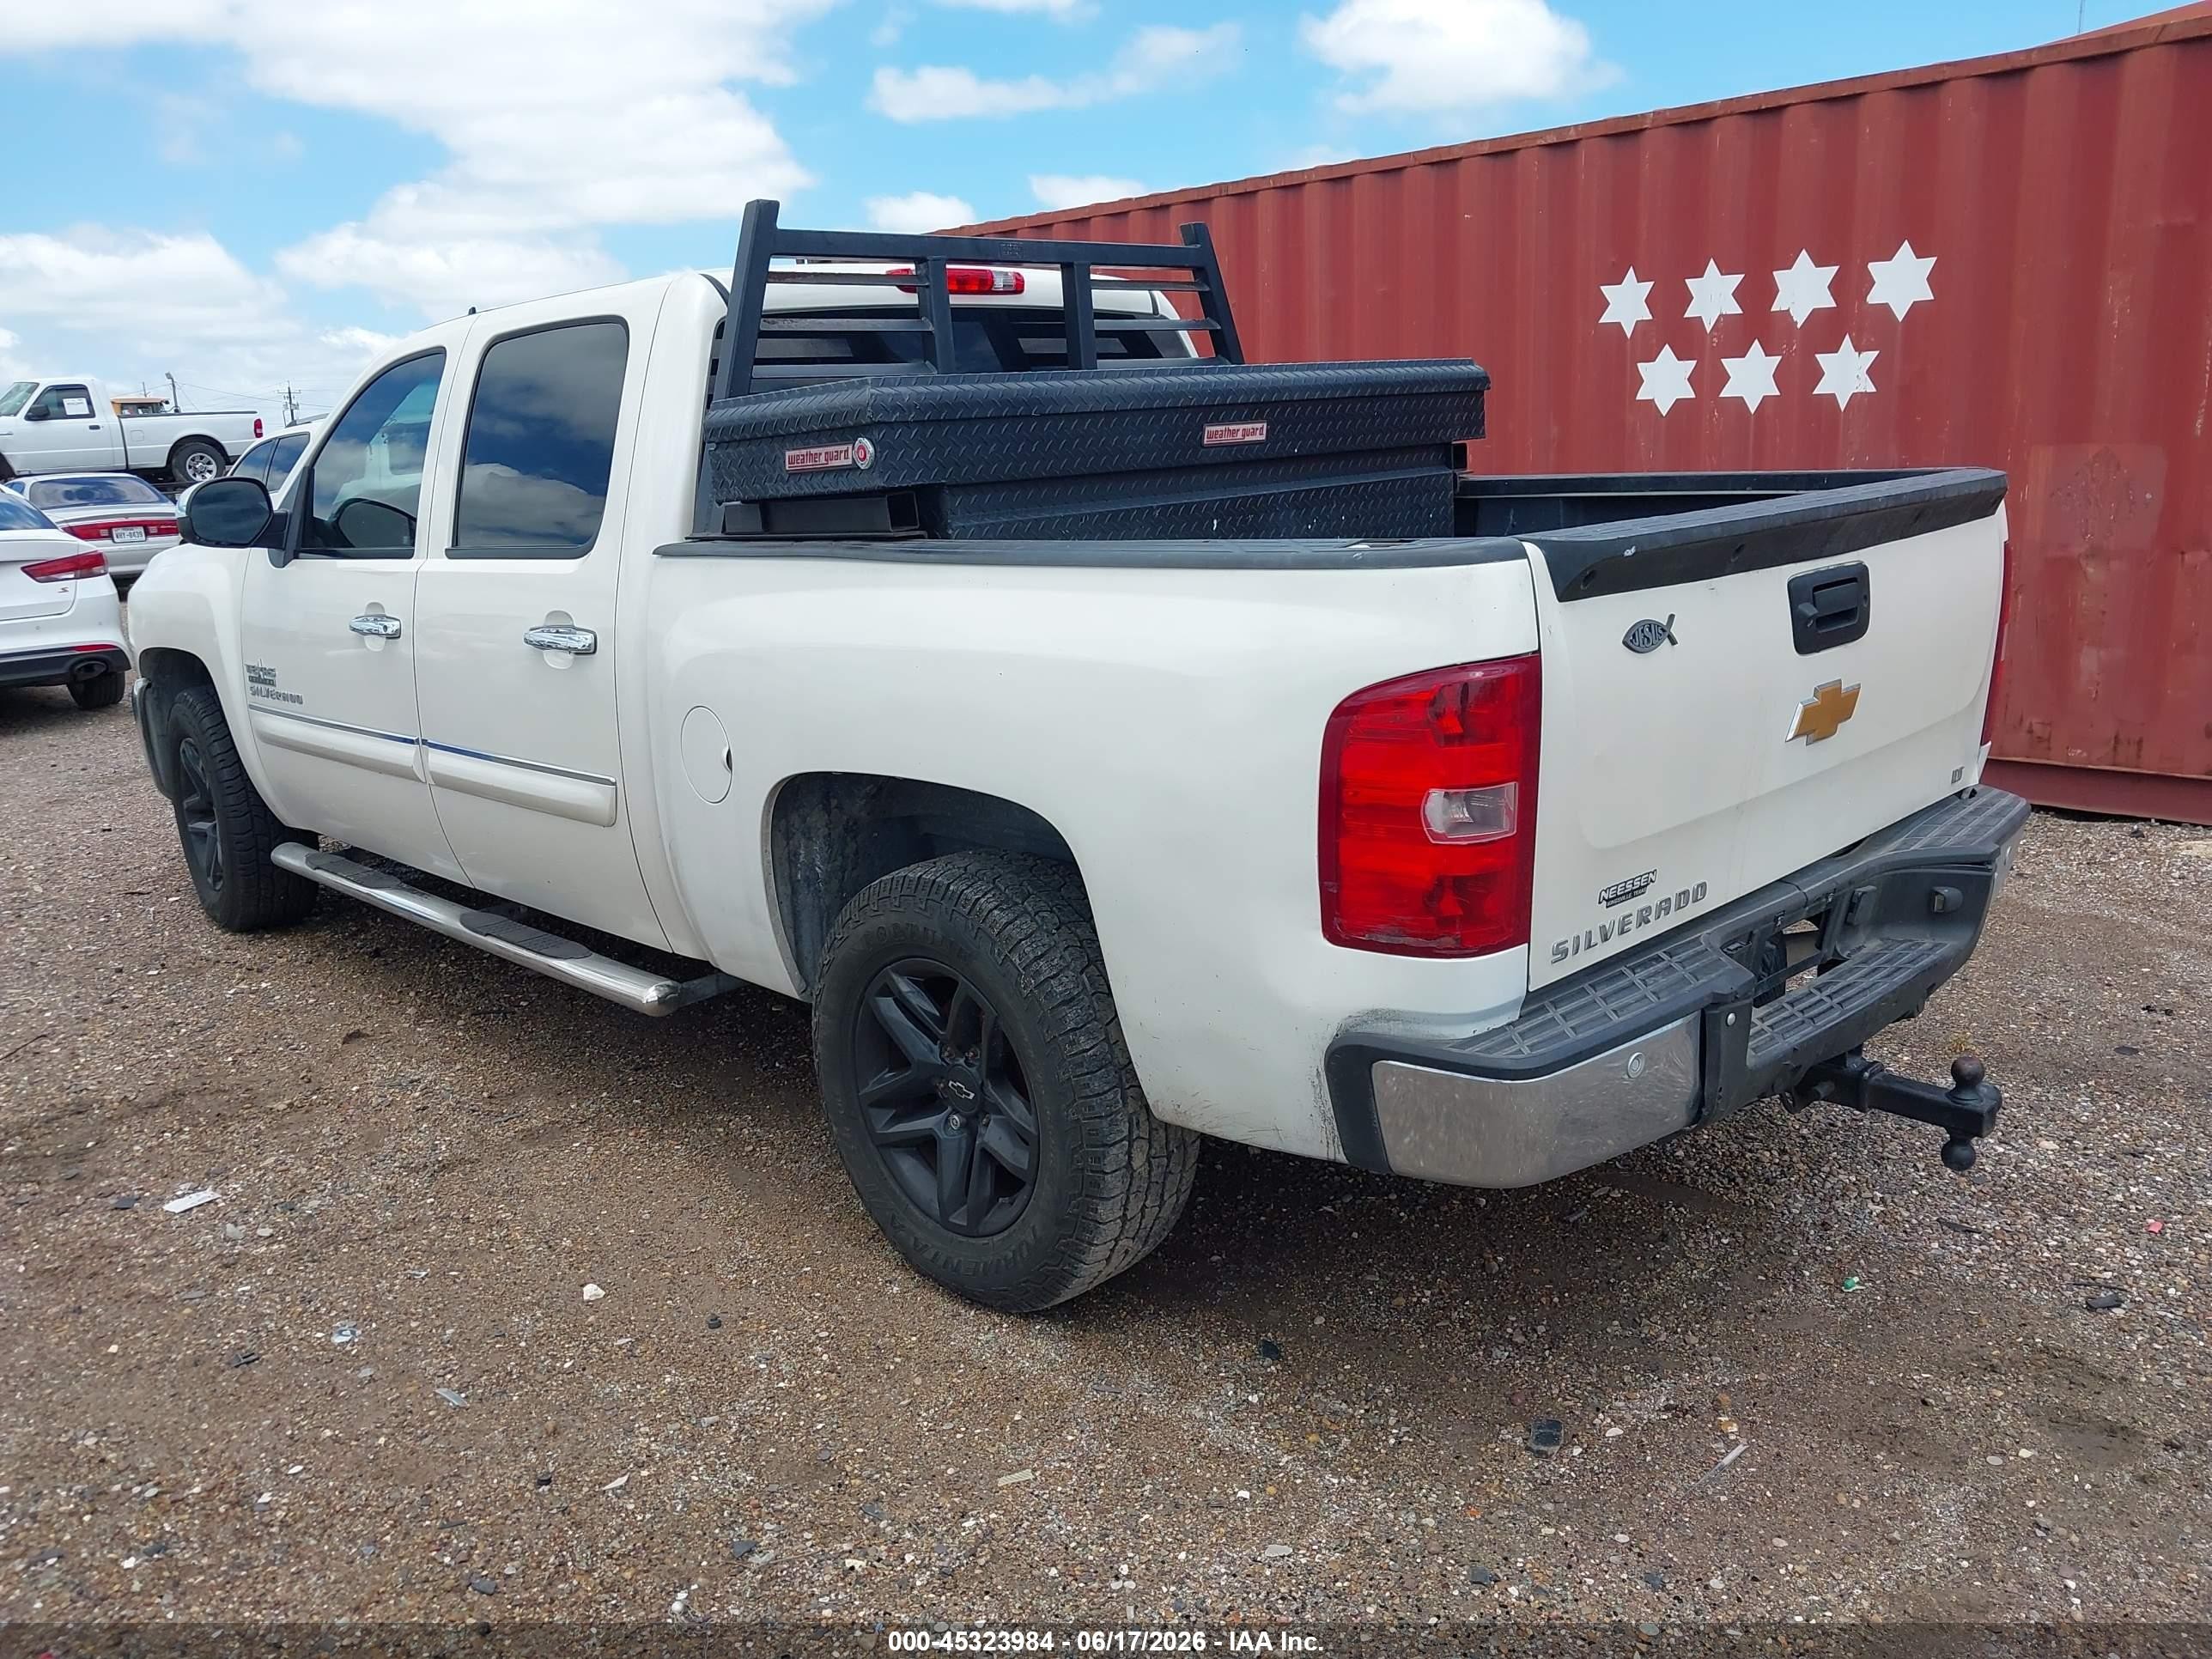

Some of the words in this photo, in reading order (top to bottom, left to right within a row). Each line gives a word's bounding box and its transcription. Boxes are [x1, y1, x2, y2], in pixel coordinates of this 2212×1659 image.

[1206, 426, 1241, 440] weather
[1242, 424, 1265, 440] guard
[787, 450, 823, 465] weather
[823, 446, 849, 466] guard
[1632, 623, 1664, 648] JESUS
[1598, 869, 1657, 904] NEESSEN
[1550, 881, 1708, 964] SILVERADO
